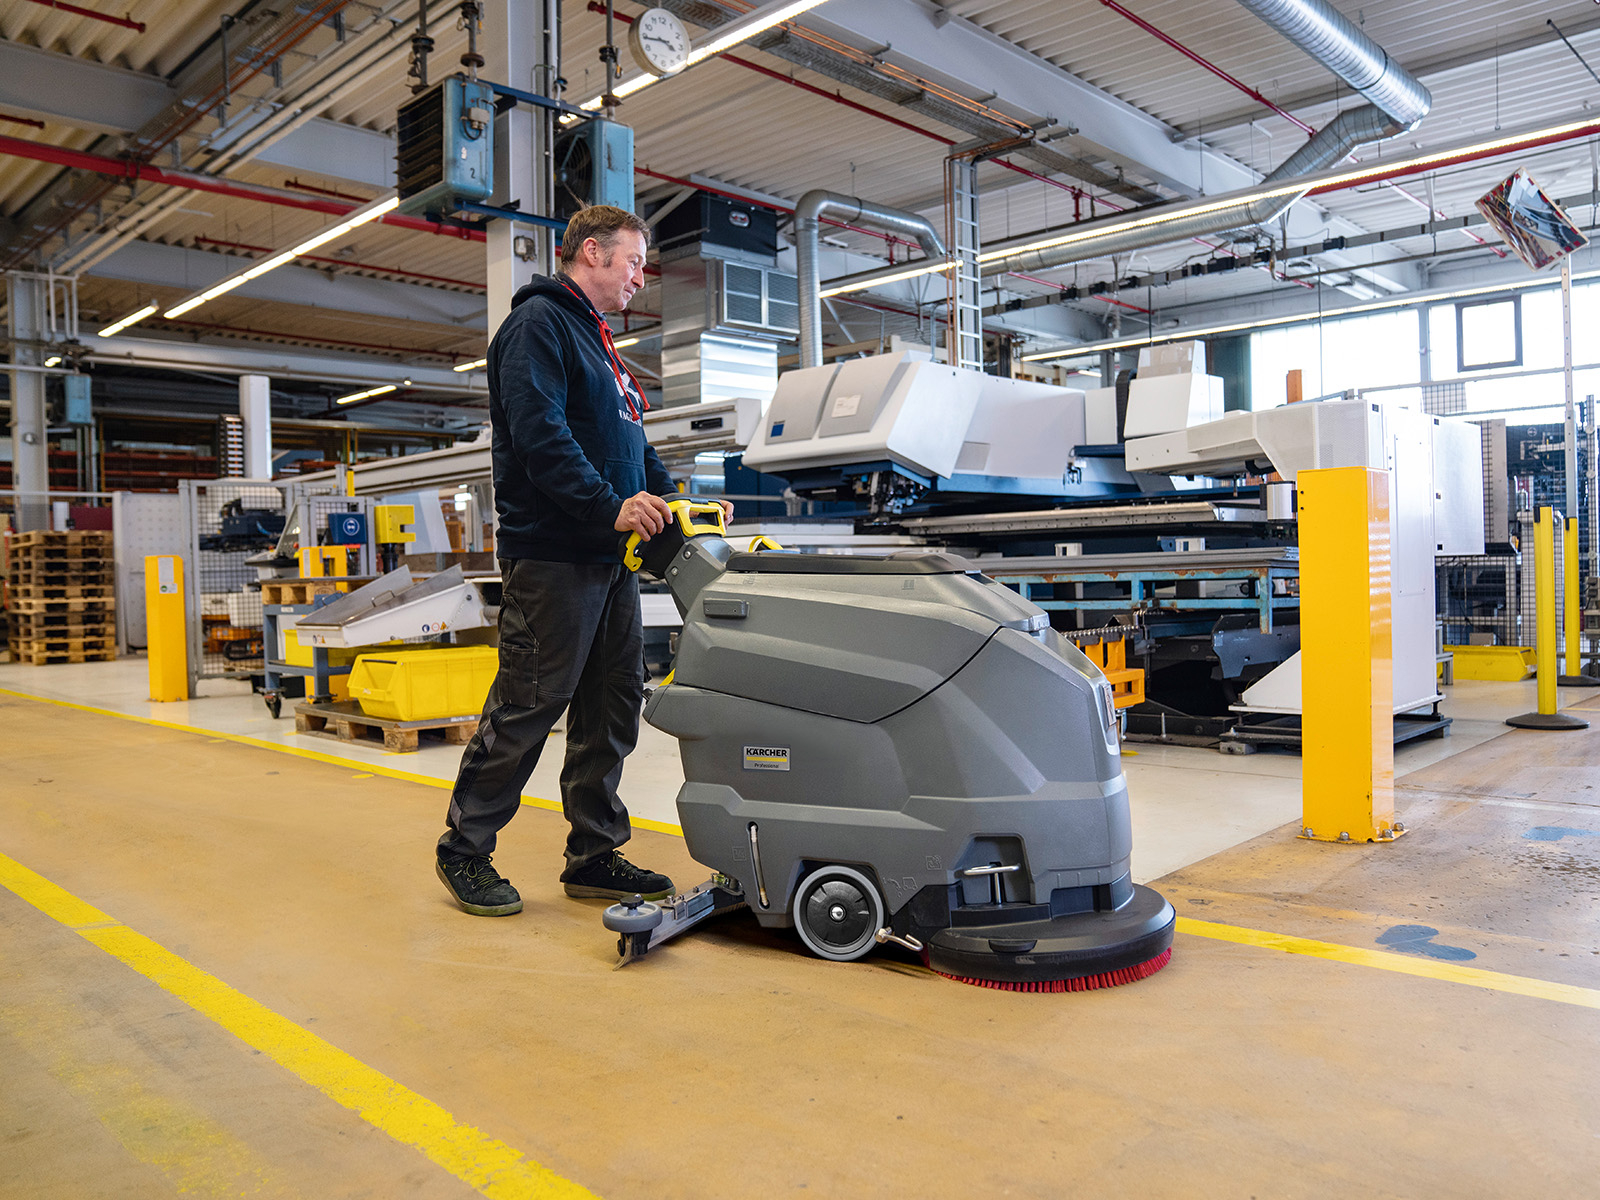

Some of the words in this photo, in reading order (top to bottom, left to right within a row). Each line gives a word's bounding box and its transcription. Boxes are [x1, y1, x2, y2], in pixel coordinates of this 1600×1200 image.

[658, 17, 666, 25] 12
[645, 23, 653, 31] 10
[675, 32, 681, 40] 2
[645, 44, 651, 52] 8
[470, 167, 475, 178] 2
[746, 748, 787, 757] KÄRCHER
